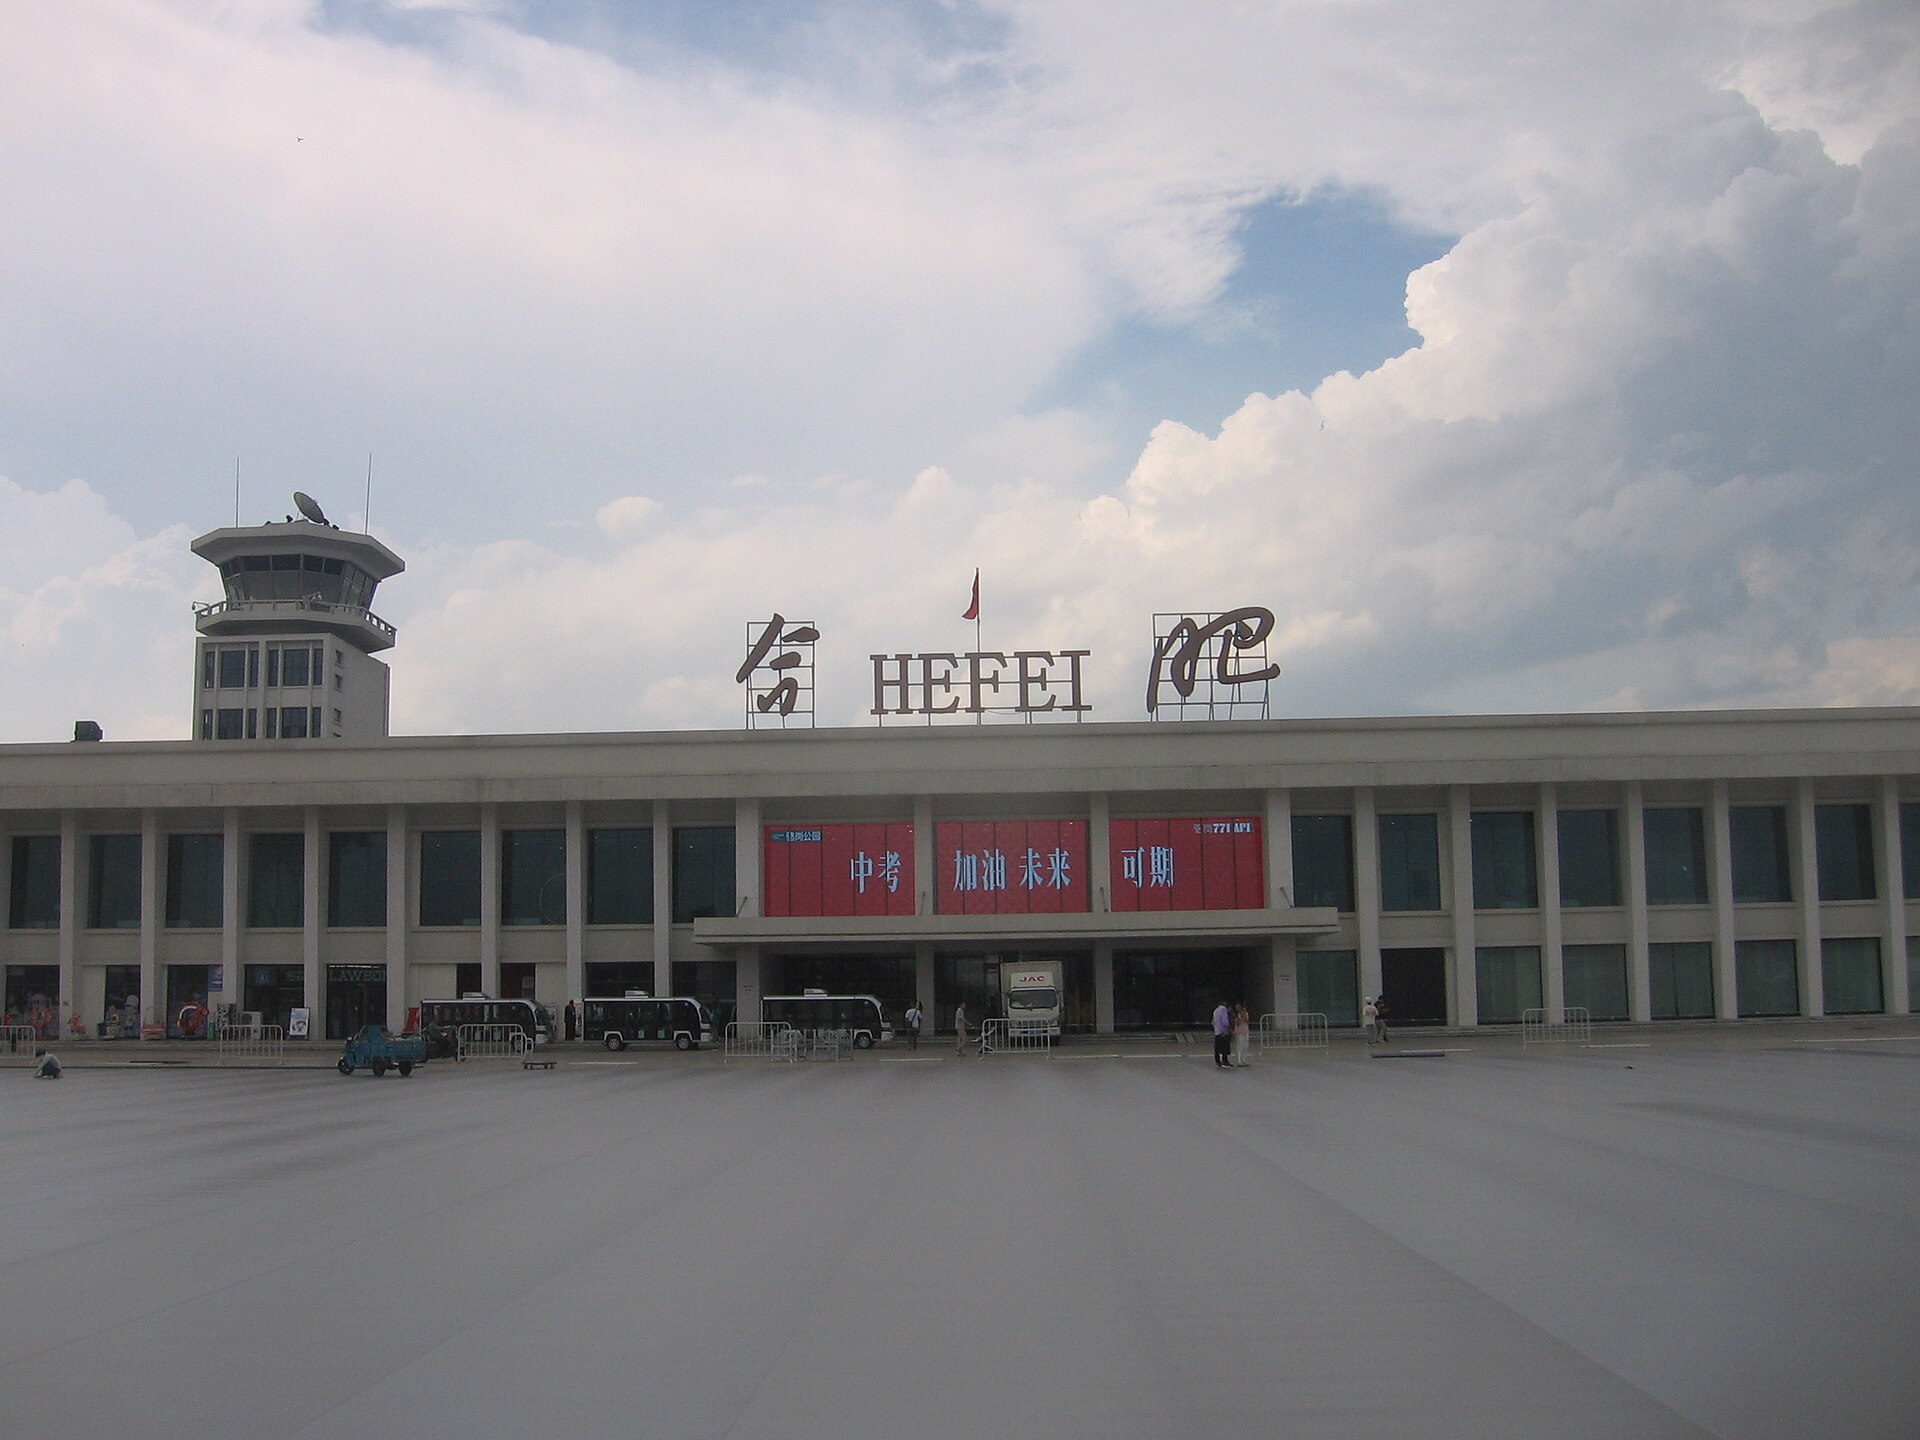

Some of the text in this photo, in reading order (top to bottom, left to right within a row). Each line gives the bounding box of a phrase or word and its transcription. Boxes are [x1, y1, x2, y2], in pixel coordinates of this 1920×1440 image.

[869, 650, 1093, 715] HEFEI
[850, 846, 1174, 893] 中考 加油 未来 可期
[1019, 975, 1046, 983] JAC
